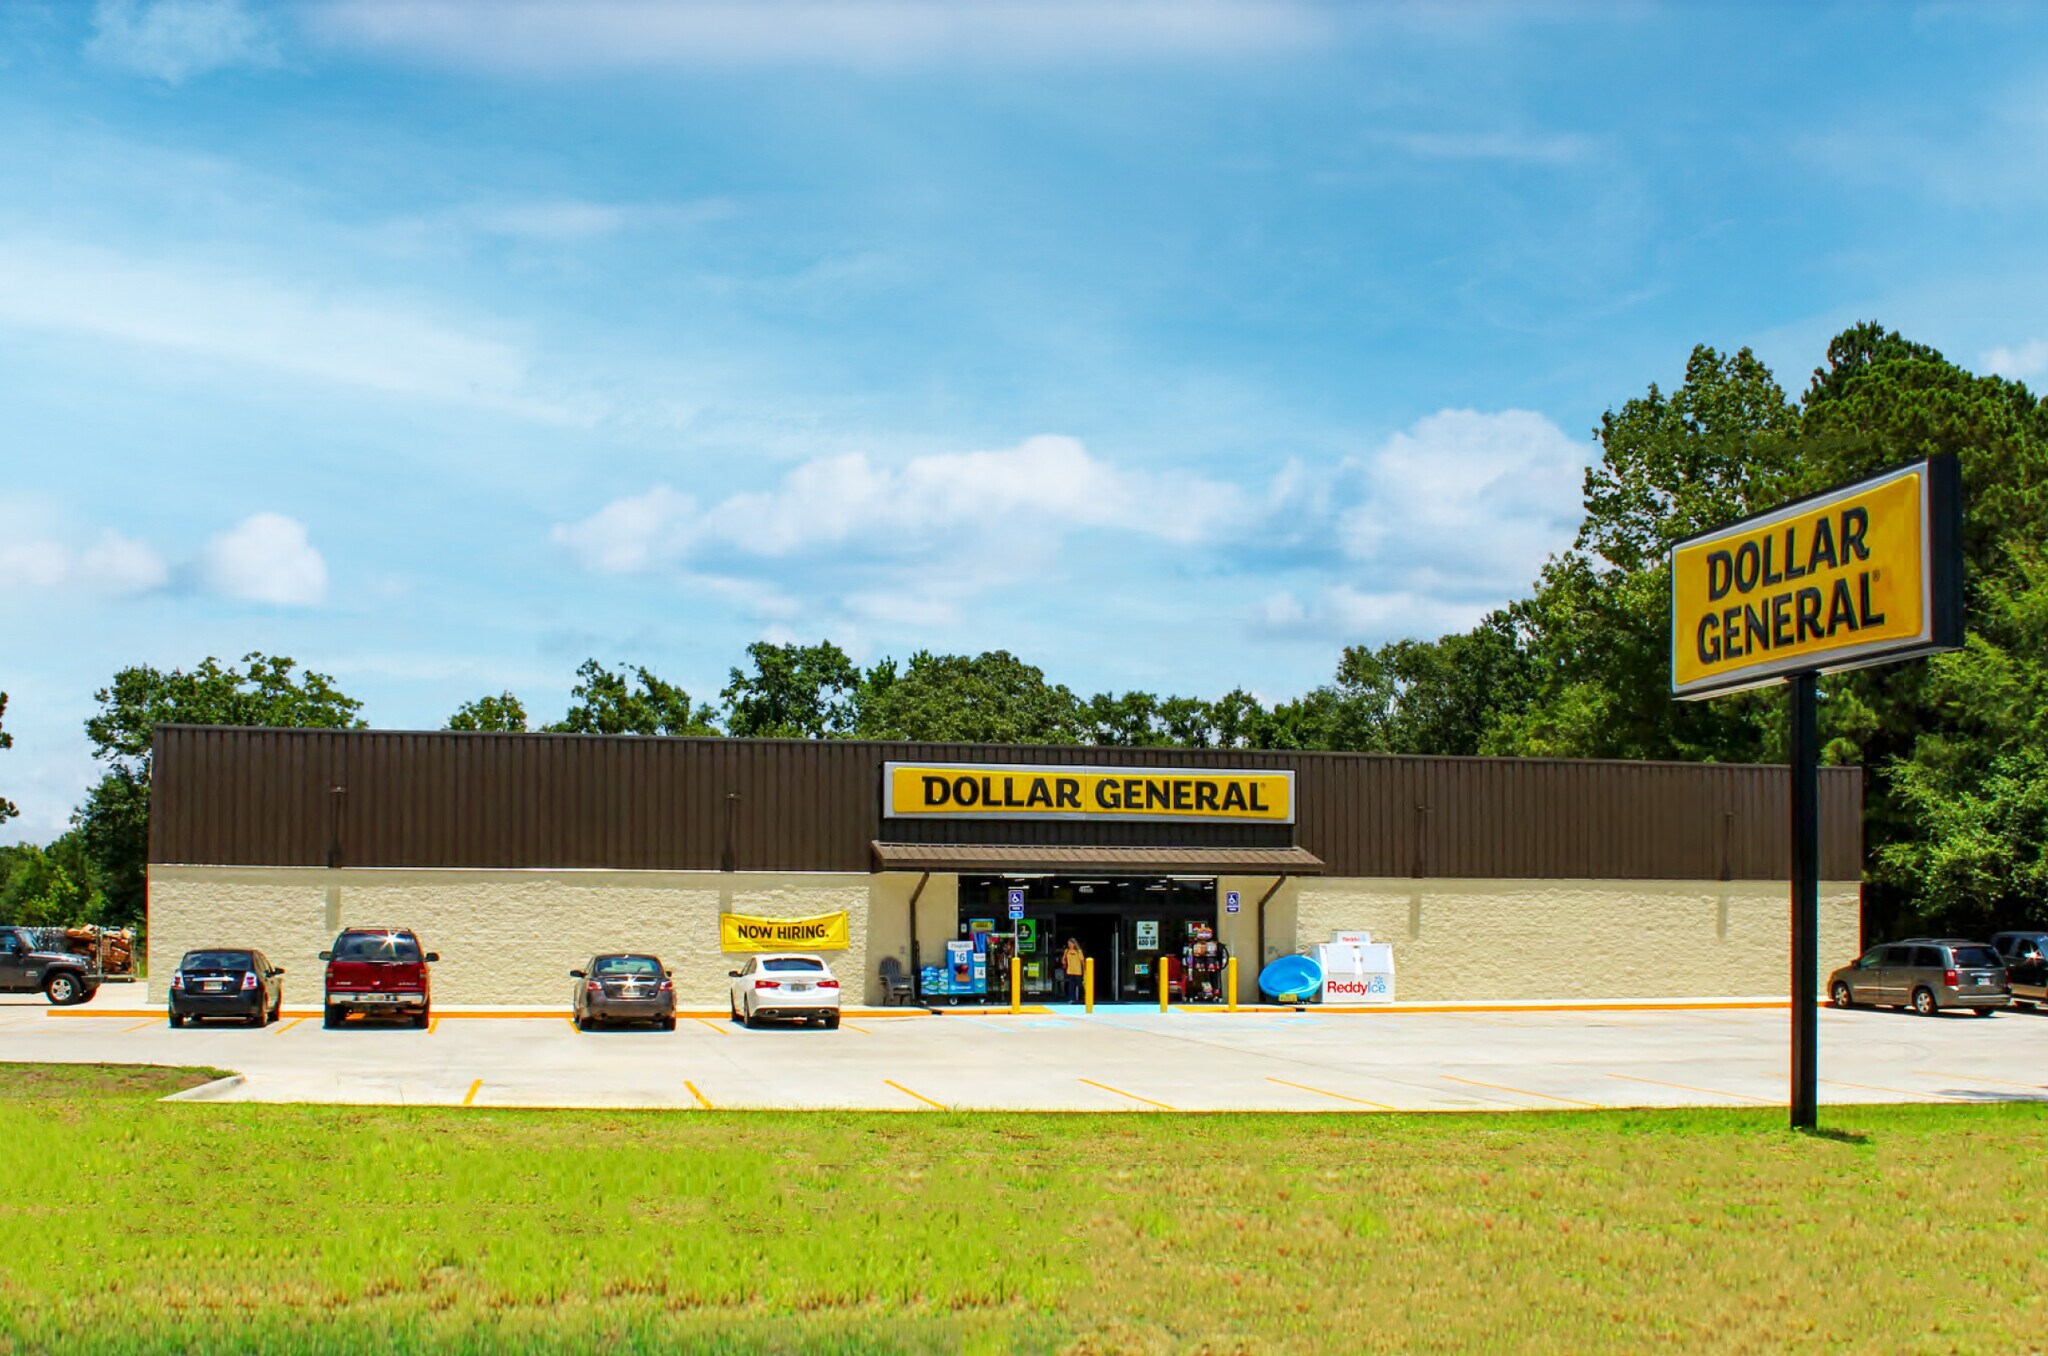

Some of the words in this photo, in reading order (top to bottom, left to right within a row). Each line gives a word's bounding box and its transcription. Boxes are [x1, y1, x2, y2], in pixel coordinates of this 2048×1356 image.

[1706, 506, 1870, 602] DOLLAR
[1697, 572, 1884, 665] GENERAL
[921, 776, 1082, 808] DOLLAR
[1095, 778, 1269, 811] GENERAL
[738, 925, 772, 938] NOW
[777, 924, 829, 939] HIRING.
